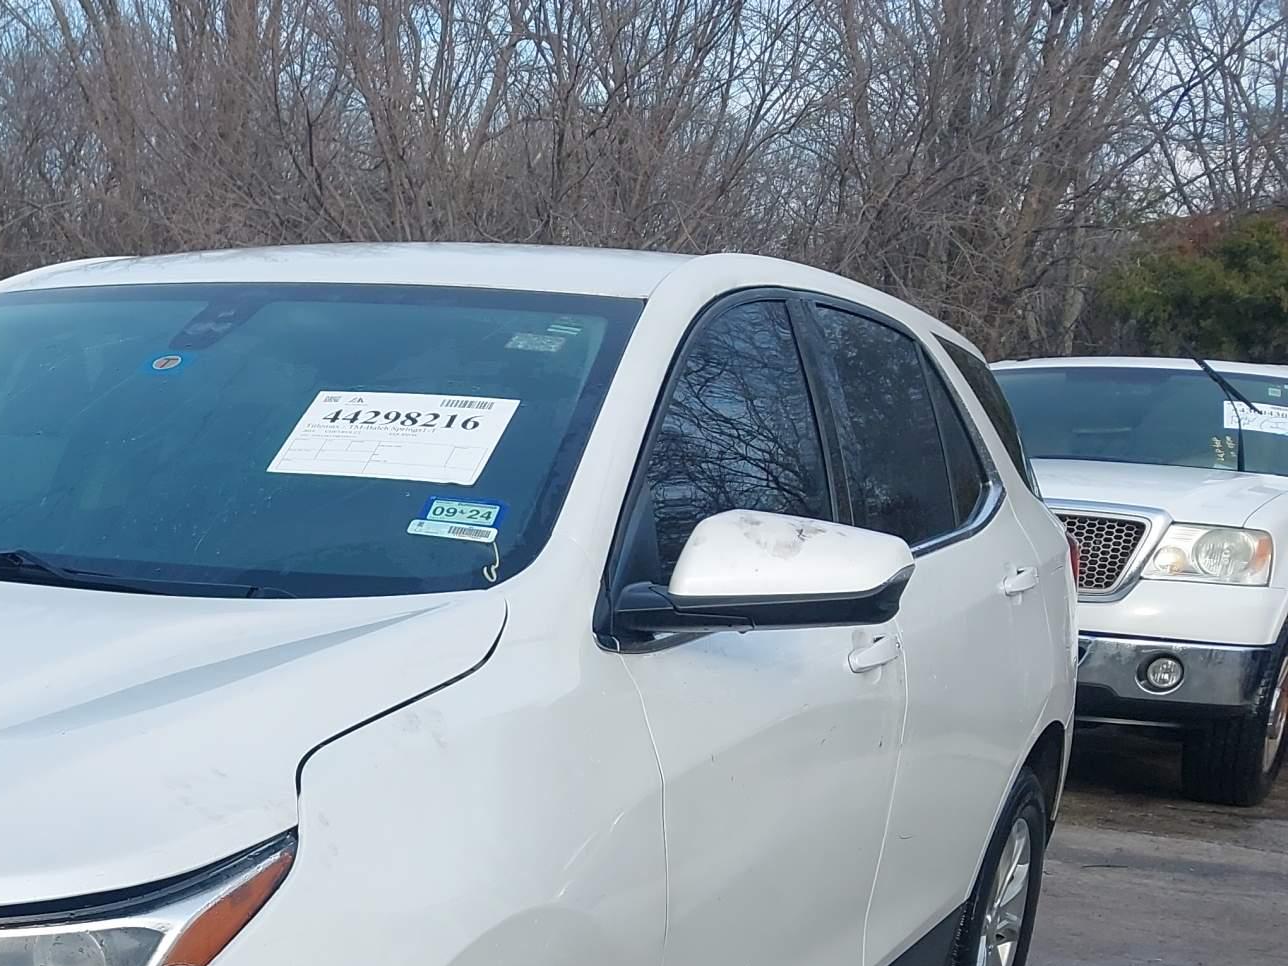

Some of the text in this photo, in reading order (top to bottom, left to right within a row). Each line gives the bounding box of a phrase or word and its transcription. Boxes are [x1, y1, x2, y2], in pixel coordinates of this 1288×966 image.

[322, 408, 484, 431] 44298216
[432, 506, 493, 521] 09 24
